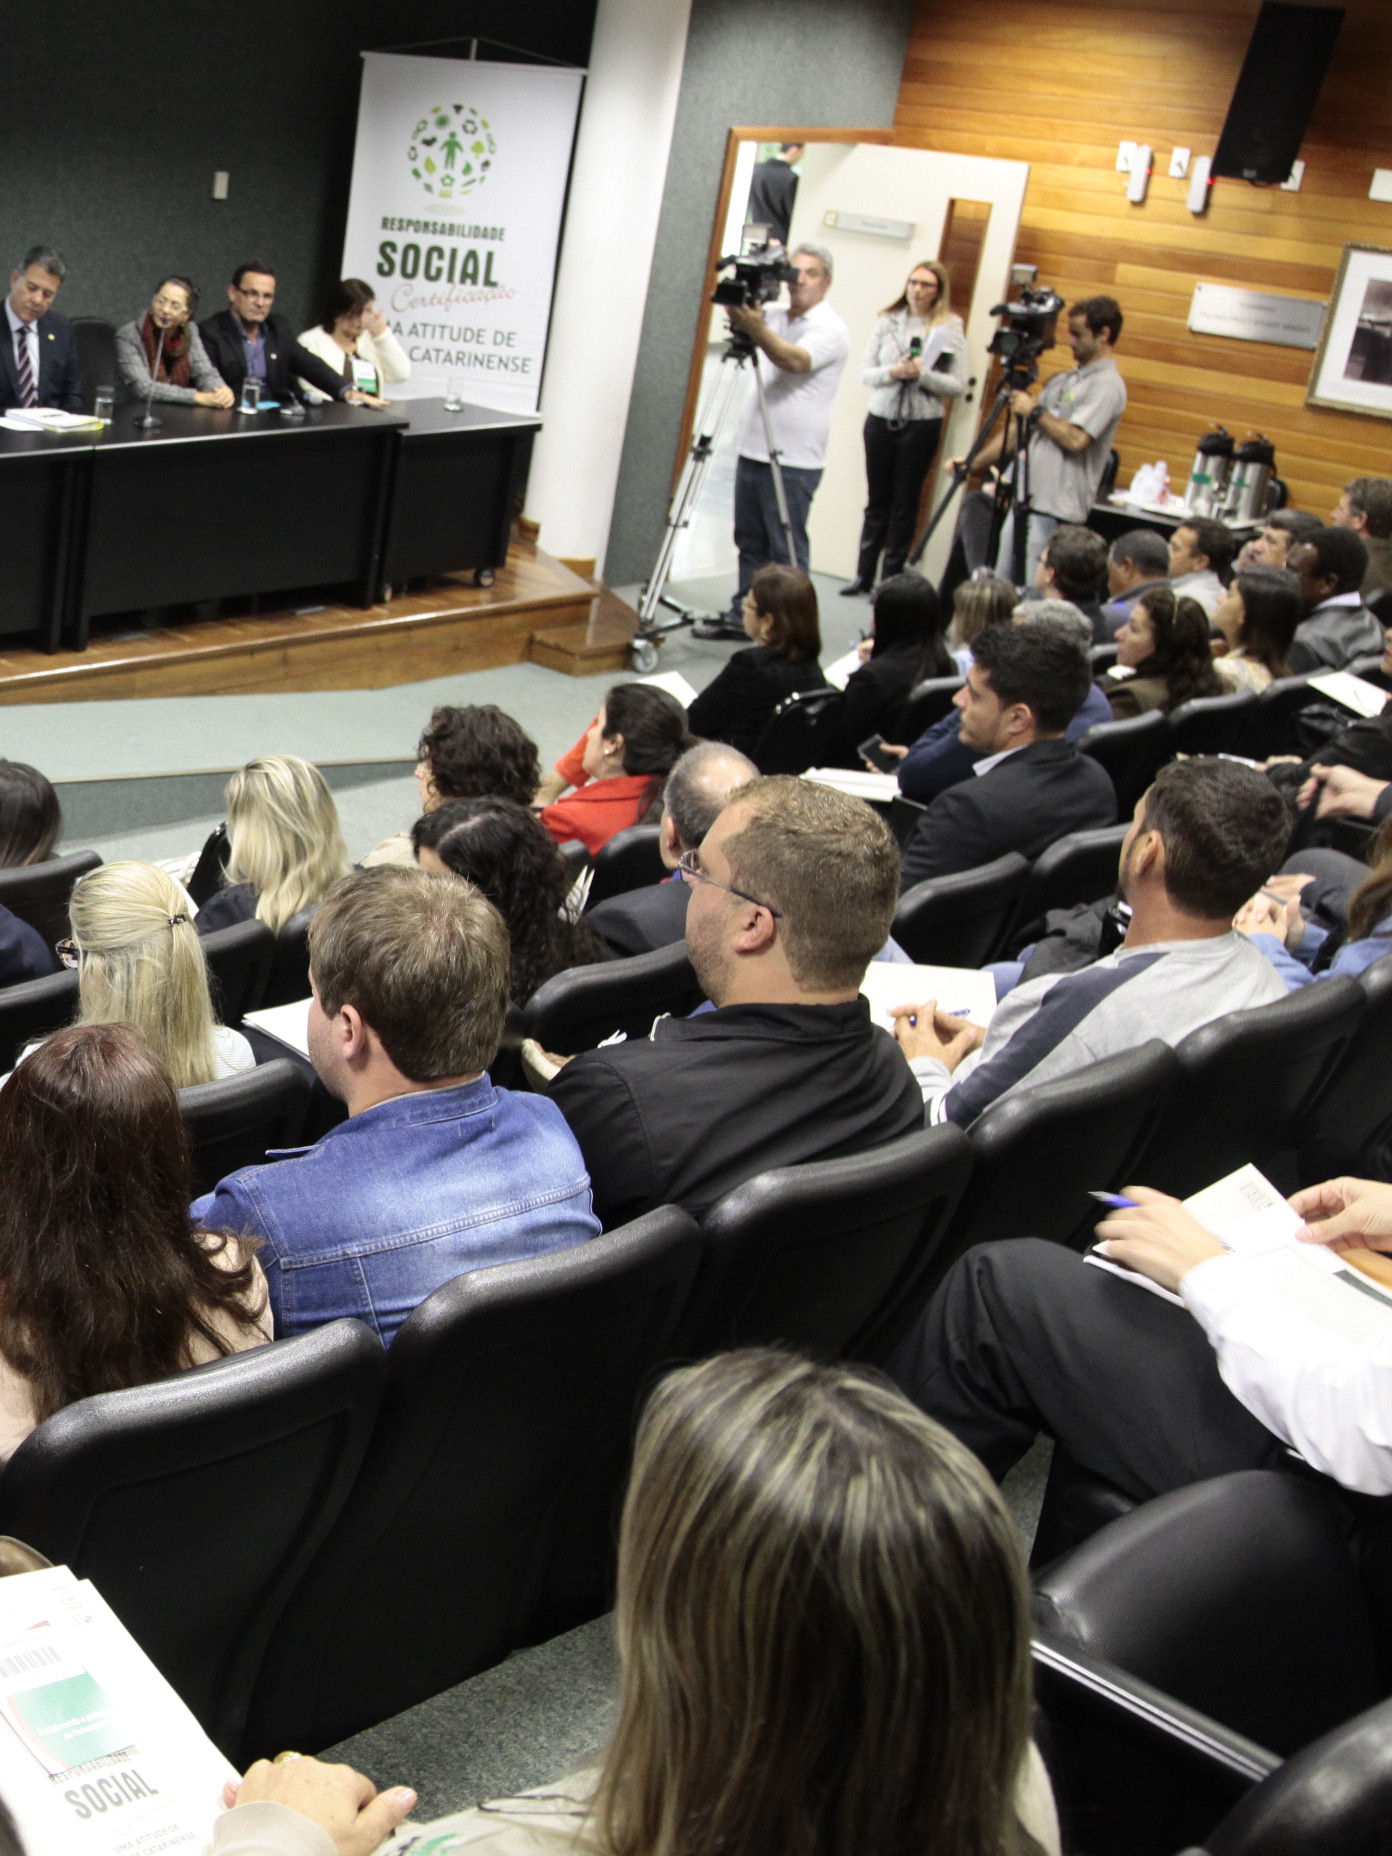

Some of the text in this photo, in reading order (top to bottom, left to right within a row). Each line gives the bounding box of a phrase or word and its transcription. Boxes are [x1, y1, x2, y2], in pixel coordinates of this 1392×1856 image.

[381, 216, 505, 241] RESPONSABILIDADE
[376, 240, 498, 287] SOCIAL
[408, 321, 486, 344] ATITUDE
[492, 330, 517, 348] DE
[408, 346, 532, 374] CATARINENSE
[64, 1769, 159, 1819] SOCIAL
[135, 1828, 171, 1846] ATITUDE
[168, 1823, 182, 1834] DE
